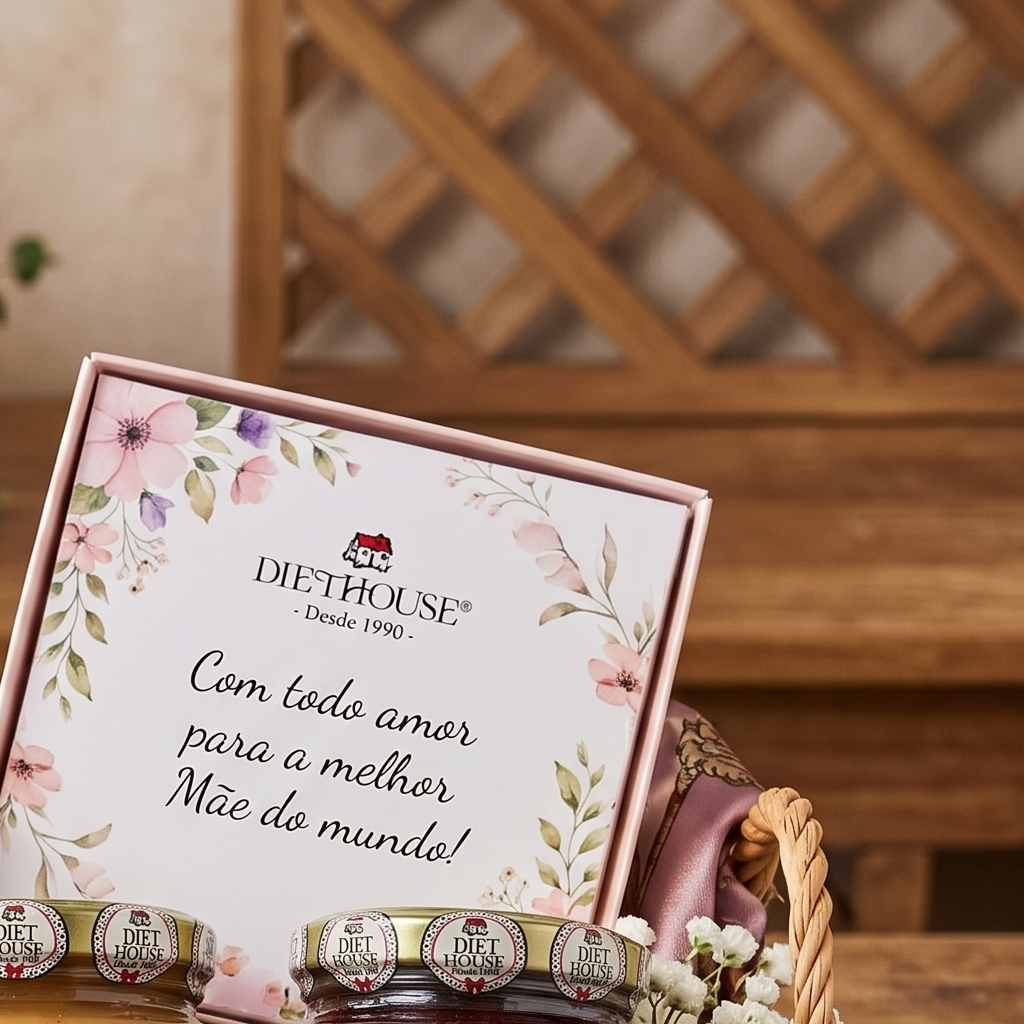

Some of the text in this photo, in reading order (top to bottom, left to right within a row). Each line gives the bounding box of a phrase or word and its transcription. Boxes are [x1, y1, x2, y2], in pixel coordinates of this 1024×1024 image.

[305, 605, 356, 629] Desde
[364, 618, 404, 639] 1990
[190, 650, 477, 746] Com todo amor
[178, 725, 454, 803] para a melhor
[166, 767, 471, 864] Mãe do mundo!
[123, 928, 161, 947] DIET
[339, 936, 373, 954] DIET
[453, 937, 500, 955] DIET
[114, 945, 164, 961] HOUSE
[332, 953, 379, 967] HOUSE
[443, 954, 505, 968] HOUSE
[578, 946, 611, 965] DIET
[569, 961, 613, 980] HOUSE
